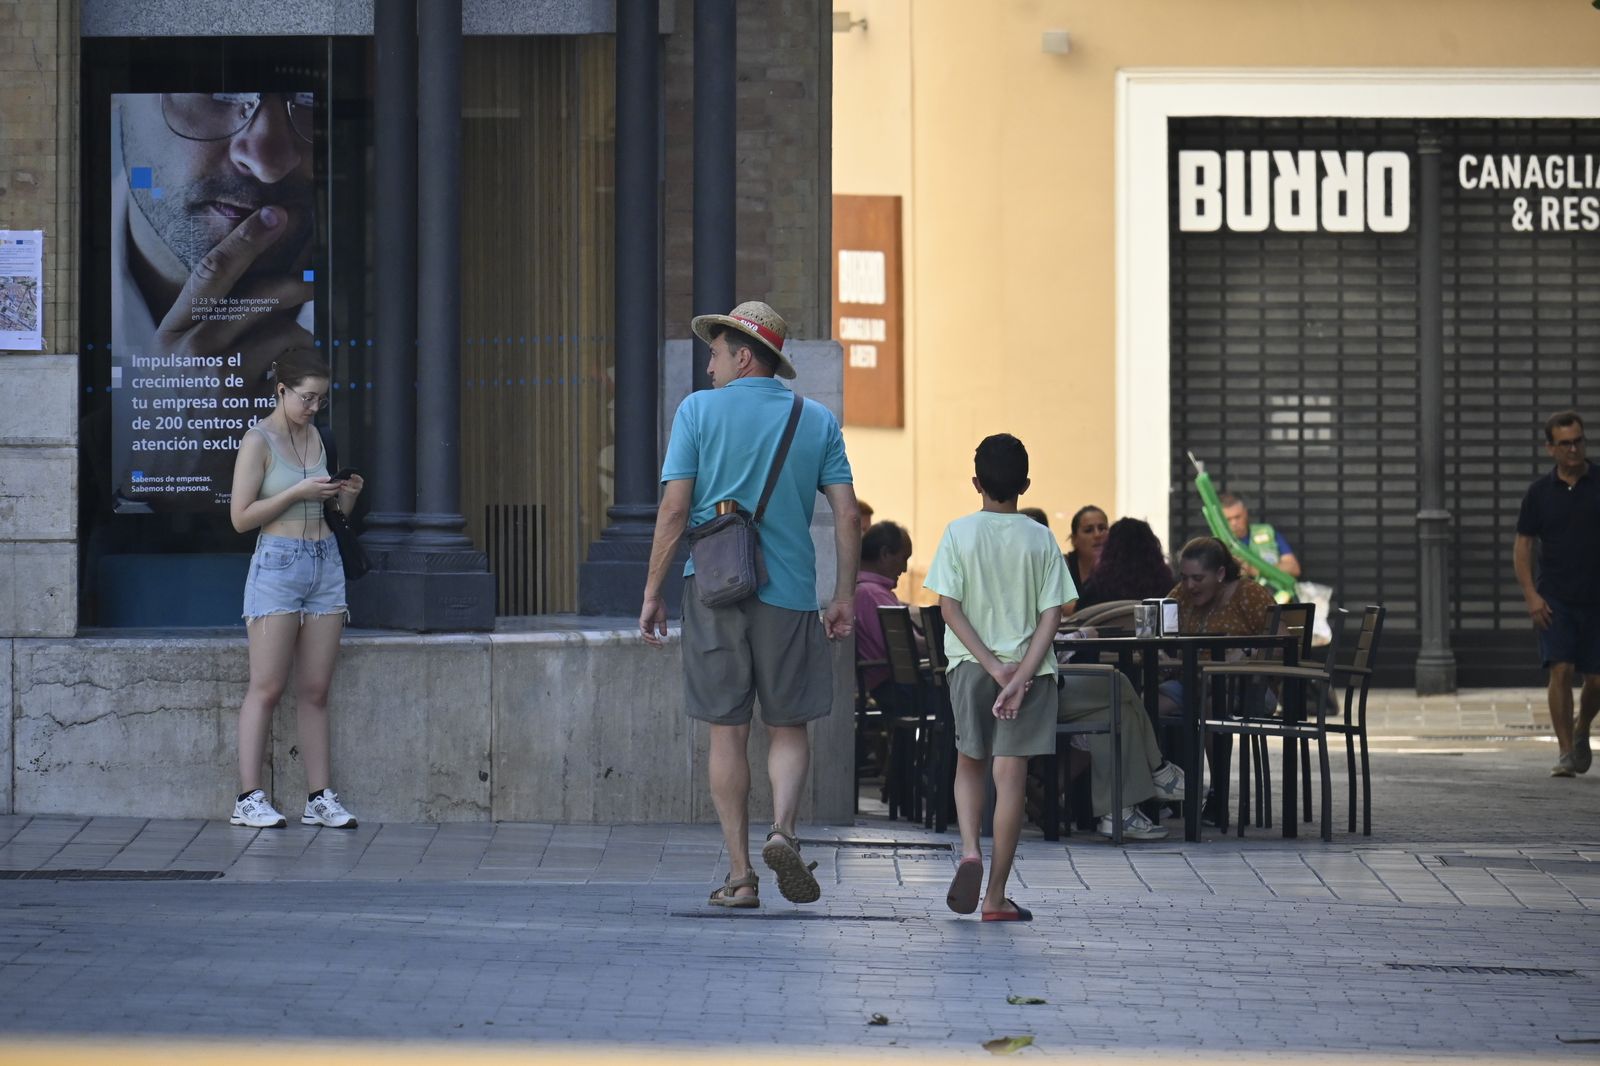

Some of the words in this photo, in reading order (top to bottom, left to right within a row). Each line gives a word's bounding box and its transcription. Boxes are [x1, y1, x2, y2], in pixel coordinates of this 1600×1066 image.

[1458, 153, 1600, 191] CANAGLI
[1178, 150, 1411, 233] BURRO
[1511, 196, 1534, 232] &
[1541, 196, 1600, 232] RES
[131, 353, 223, 370] Impulsamos
[227, 352, 241, 368] el
[131, 374, 220, 389] crecimiento
[224, 373, 244, 388] de
[131, 397, 148, 410] tu
[152, 397, 217, 412] empresa
[222, 396, 249, 409] con
[254, 394, 277, 409] má
[131, 416, 150, 431] de
[155, 416, 183, 430] 200
[187, 416, 243, 430] centros
[131, 436, 198, 451] atención
[202, 435, 241, 450] exclu
[165, 475, 175, 483] de
[176, 476, 212, 484] empresas.
[131, 485, 164, 493] Sabemos
[165, 484, 175, 492] de
[176, 485, 211, 493] personas.
